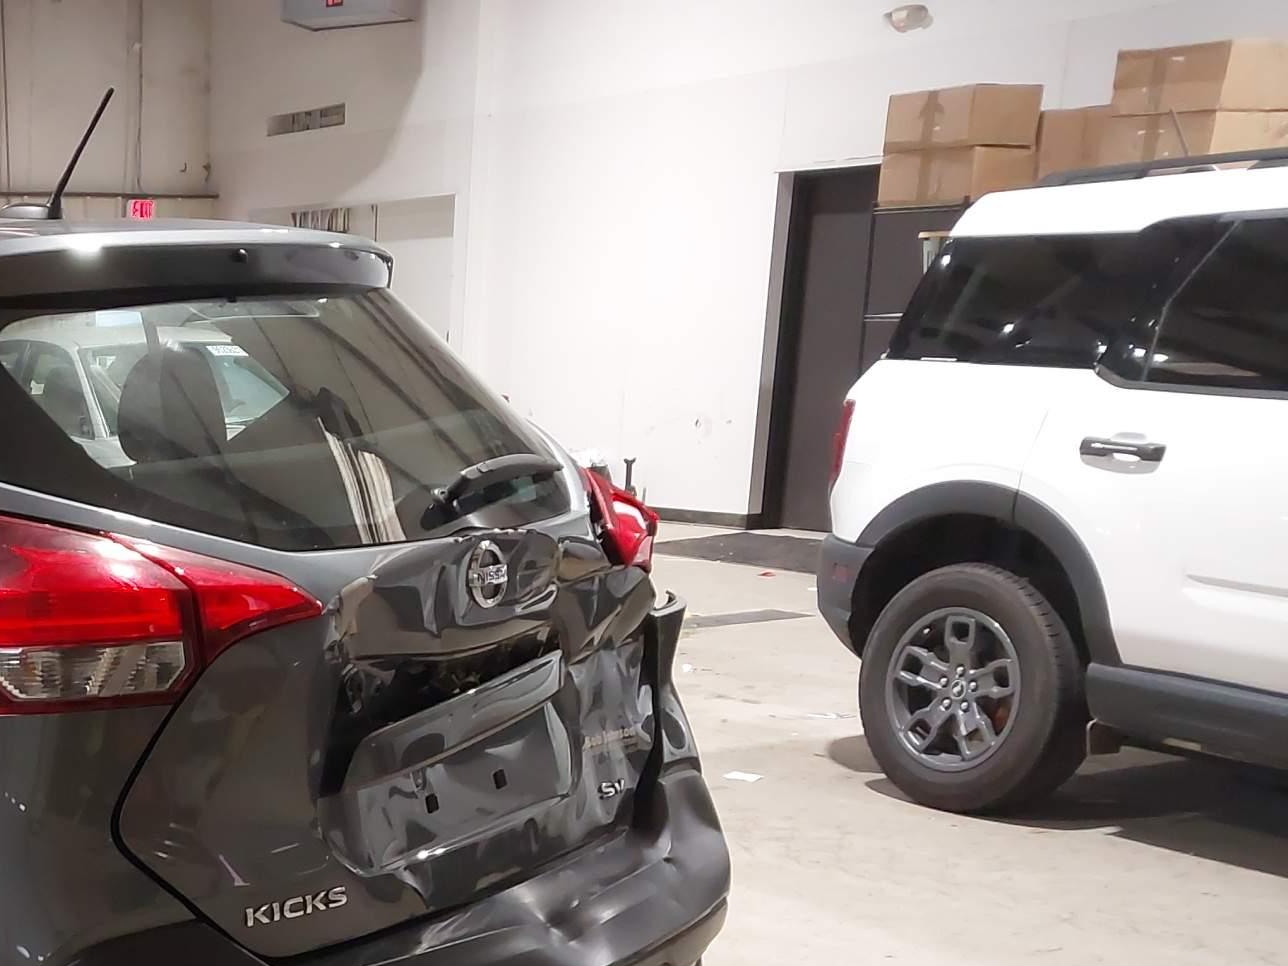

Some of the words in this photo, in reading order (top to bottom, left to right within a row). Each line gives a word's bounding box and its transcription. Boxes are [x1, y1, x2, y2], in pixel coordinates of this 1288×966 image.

[477, 567, 505, 584] NISSA
[600, 779, 625, 798] SV
[245, 885, 348, 928] KICKS
